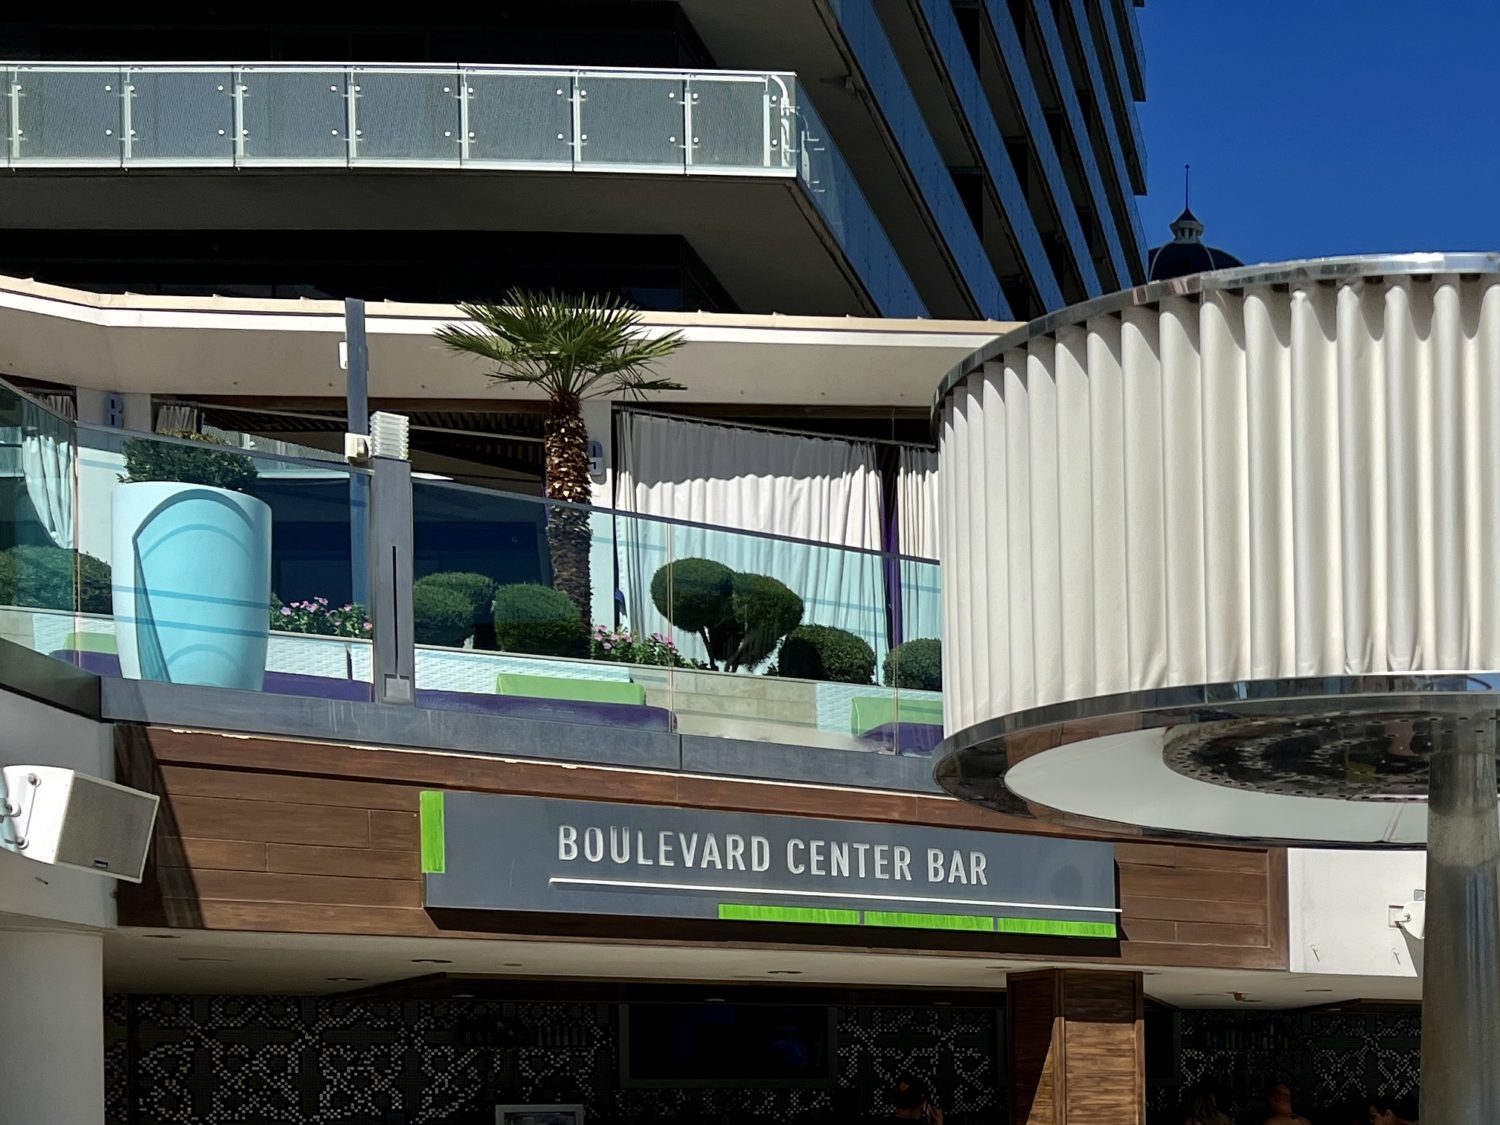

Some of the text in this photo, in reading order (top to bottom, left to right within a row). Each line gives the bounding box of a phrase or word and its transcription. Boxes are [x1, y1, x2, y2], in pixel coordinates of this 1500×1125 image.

[558, 824, 988, 885] BOULEVARD CENTER BAR
